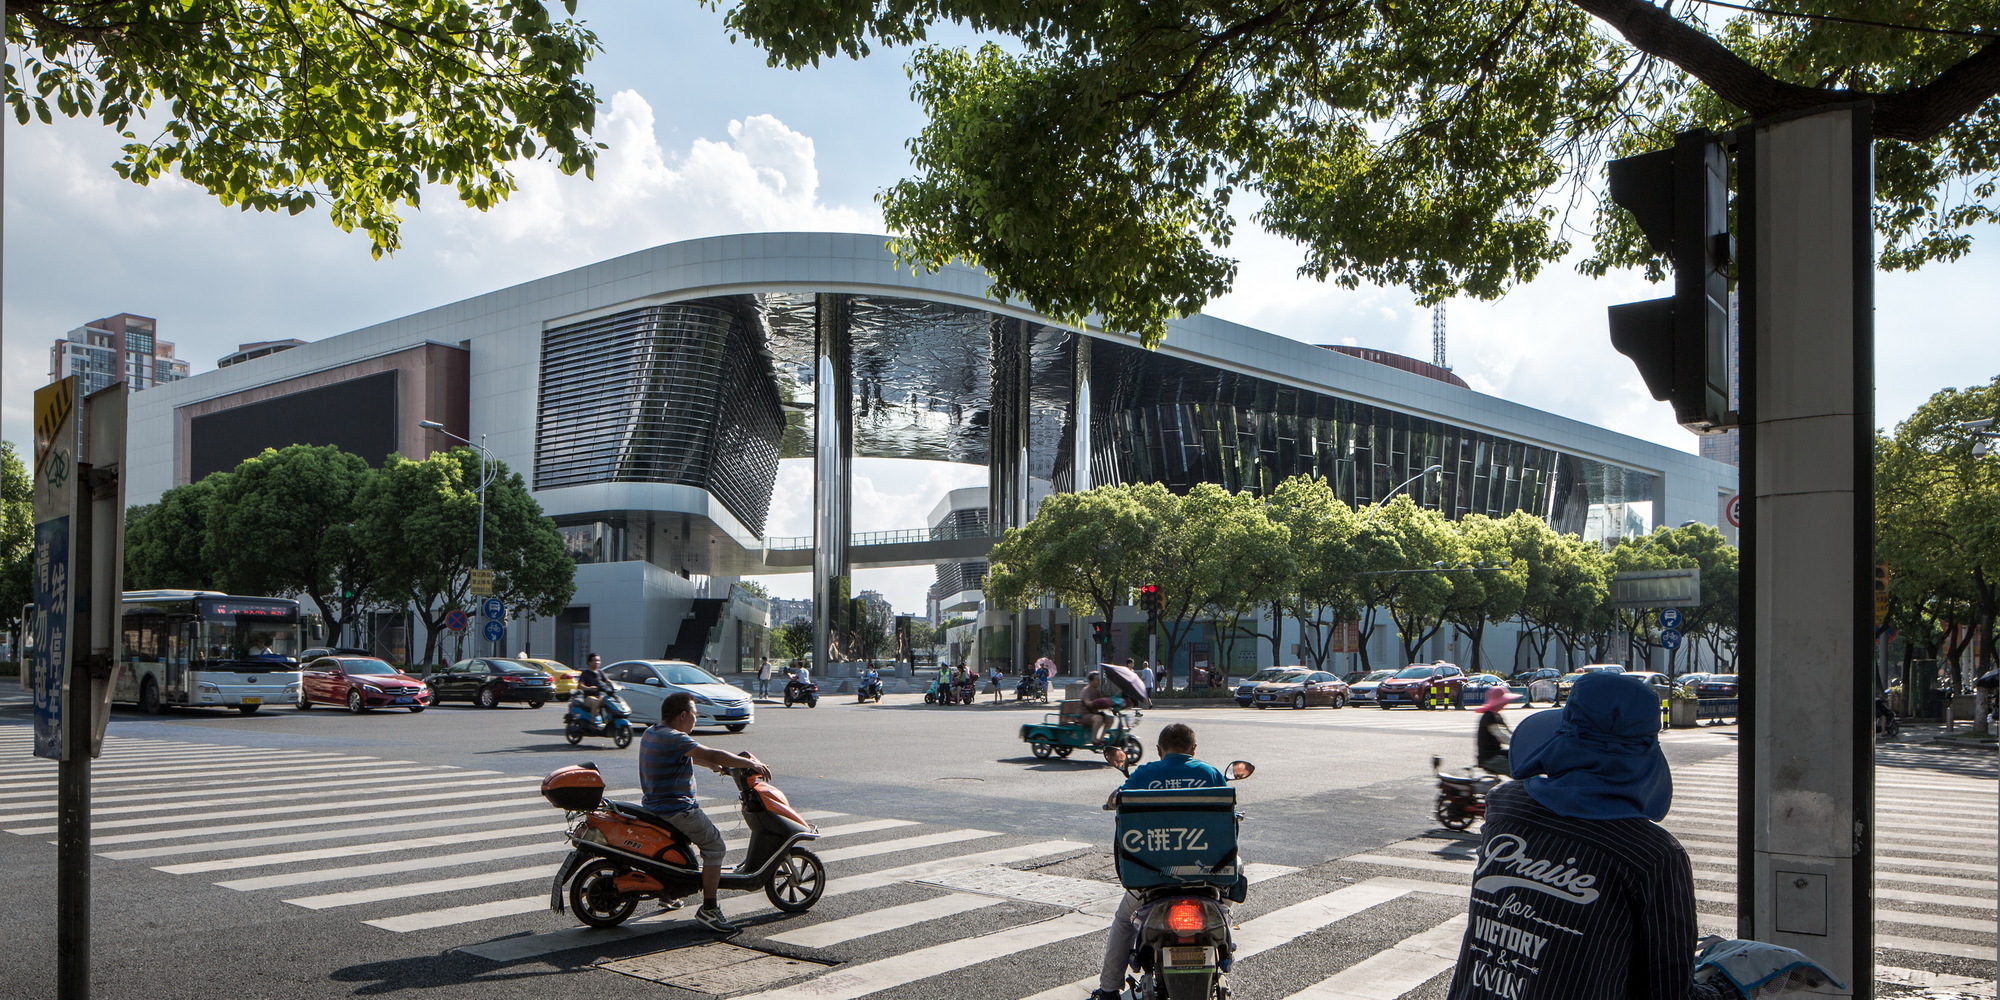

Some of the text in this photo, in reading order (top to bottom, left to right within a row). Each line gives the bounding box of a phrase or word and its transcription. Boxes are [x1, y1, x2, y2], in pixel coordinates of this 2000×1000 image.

[1476, 833, 1597, 893] Praise
[1498, 892, 1536, 919] for
[1474, 915, 1549, 960] VICTORY
[1496, 949, 1508, 968] &
[1472, 960, 1527, 1000] WIN
